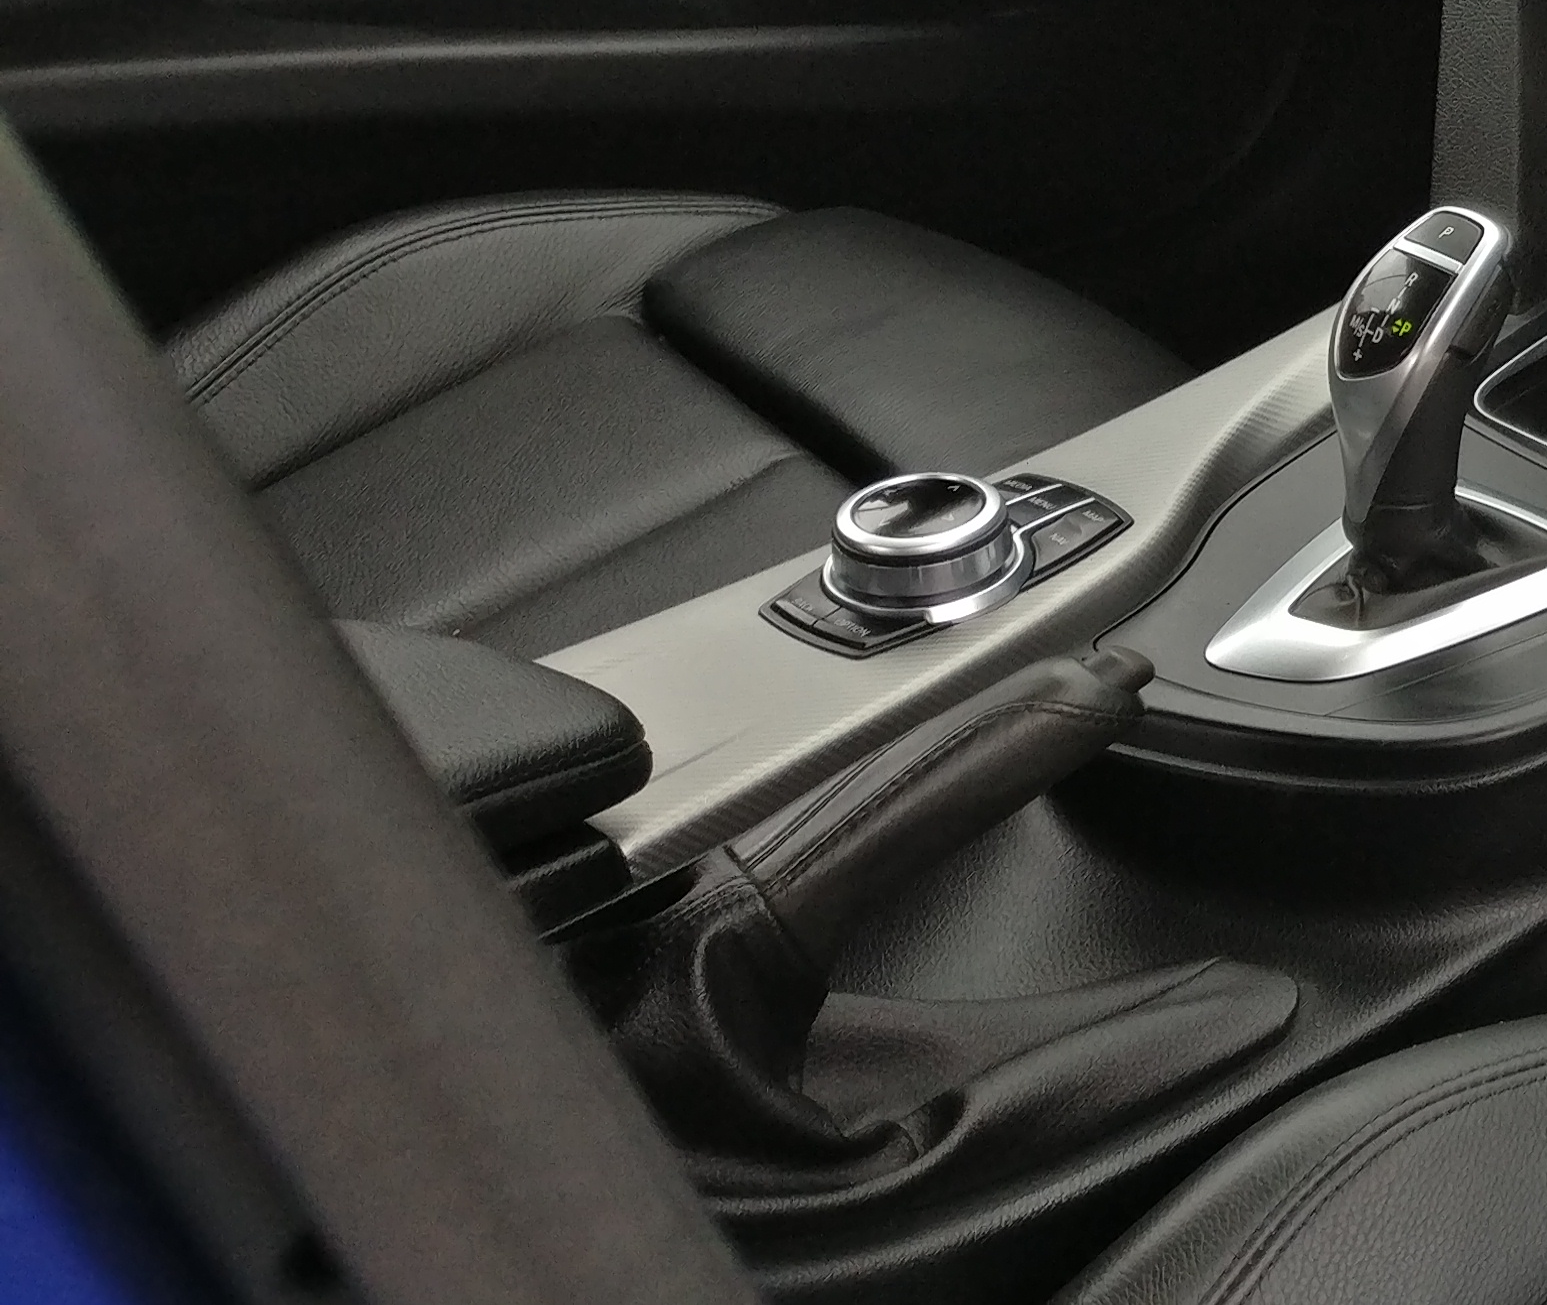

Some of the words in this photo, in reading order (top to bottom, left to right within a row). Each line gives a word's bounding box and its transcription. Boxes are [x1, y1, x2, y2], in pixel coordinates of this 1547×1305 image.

[1438, 226, 1455, 239] P
[1405, 272, 1419, 287] R
[1386, 297, 1400, 315] N
[1371, 326, 1384, 344] D
[1398, 321, 1412, 337] P
[833, 618, 872, 638] OPTION
